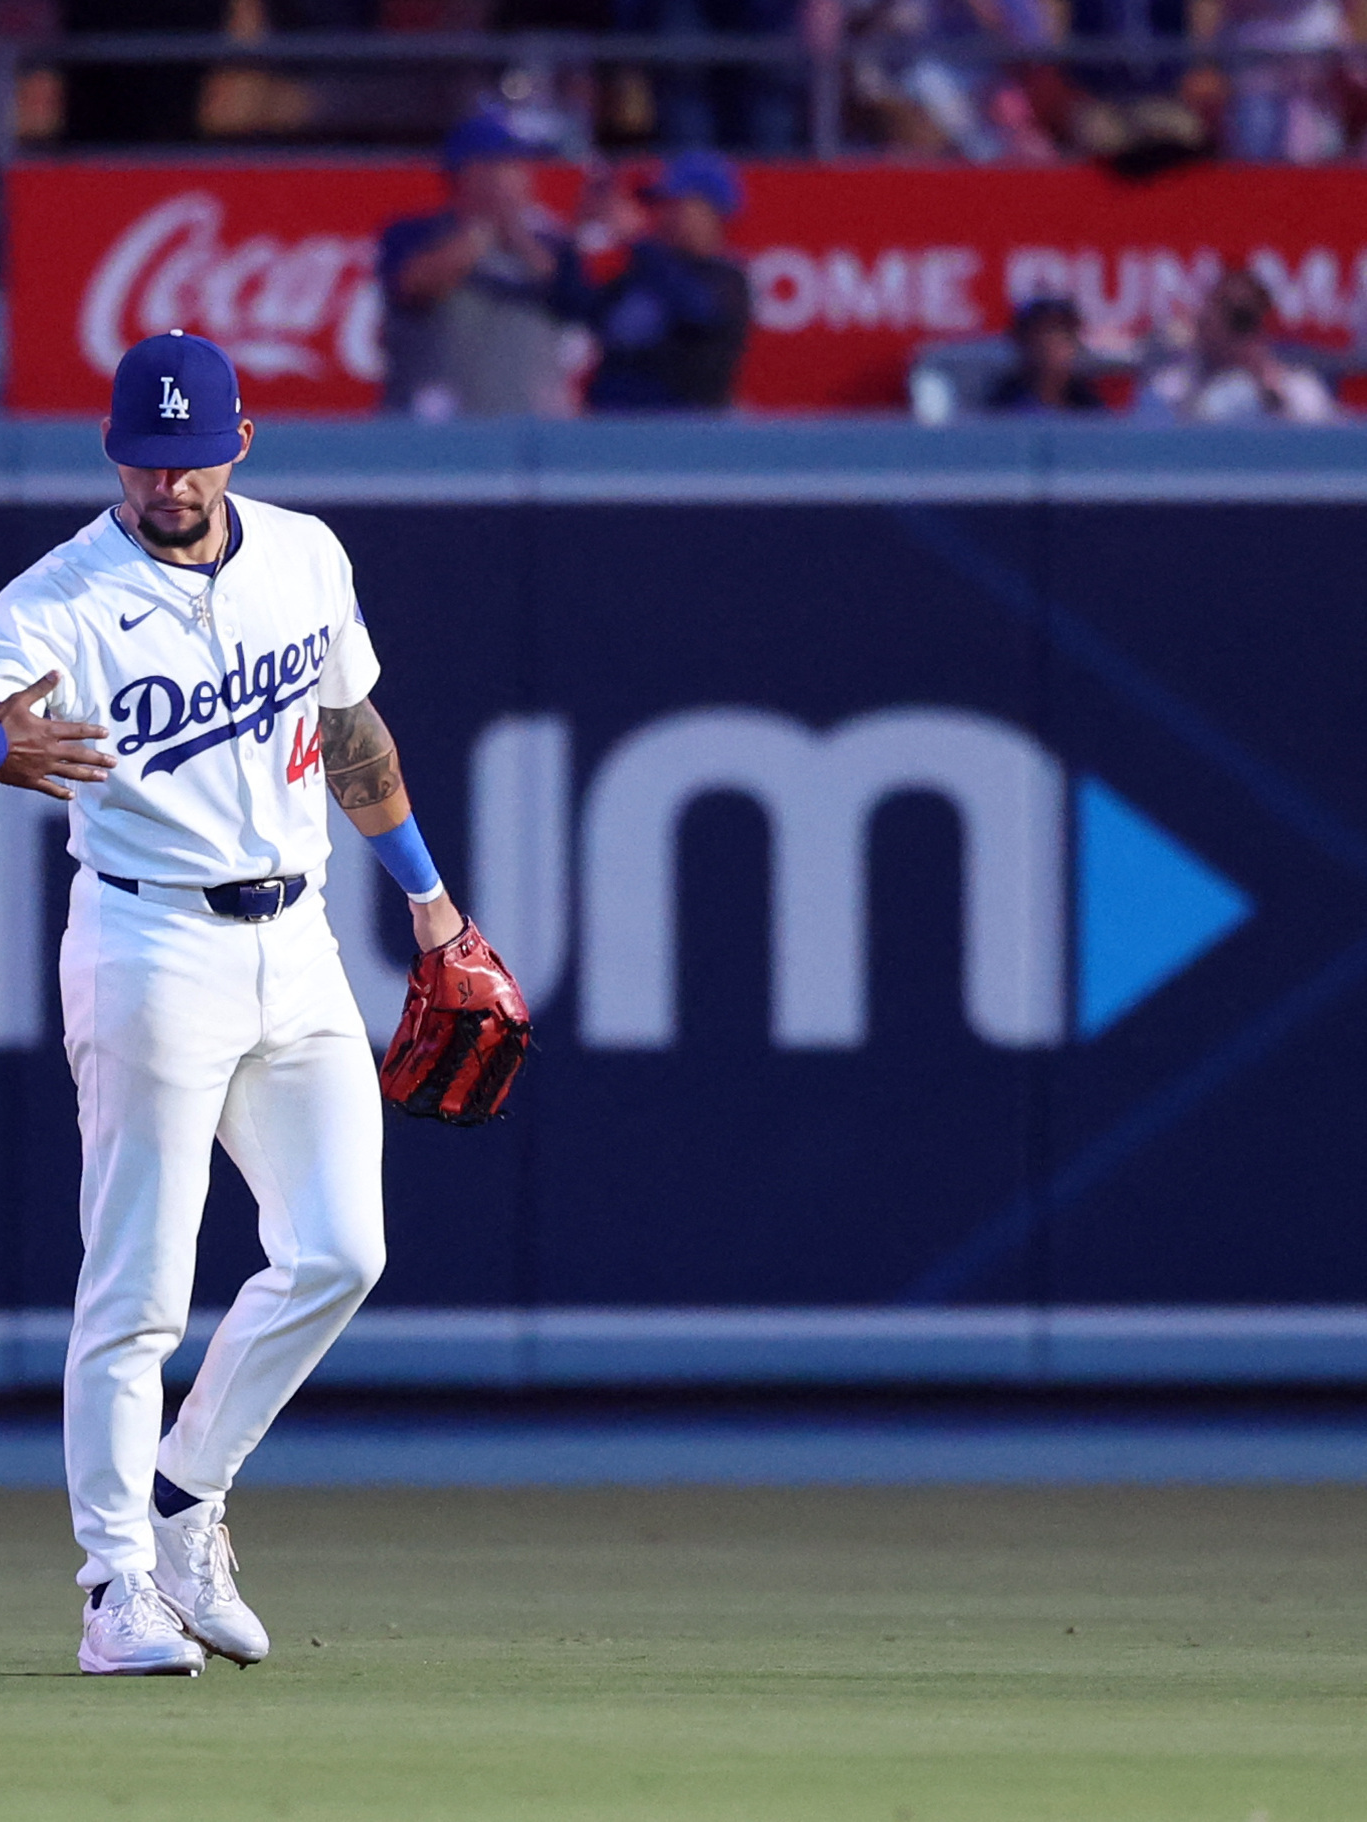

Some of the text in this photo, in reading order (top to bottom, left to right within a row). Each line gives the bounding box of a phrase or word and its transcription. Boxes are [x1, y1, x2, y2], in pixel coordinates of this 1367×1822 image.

[746, 246, 984, 332] OME
[159, 376, 190, 420] LA
[286, 716, 325, 790] 44
